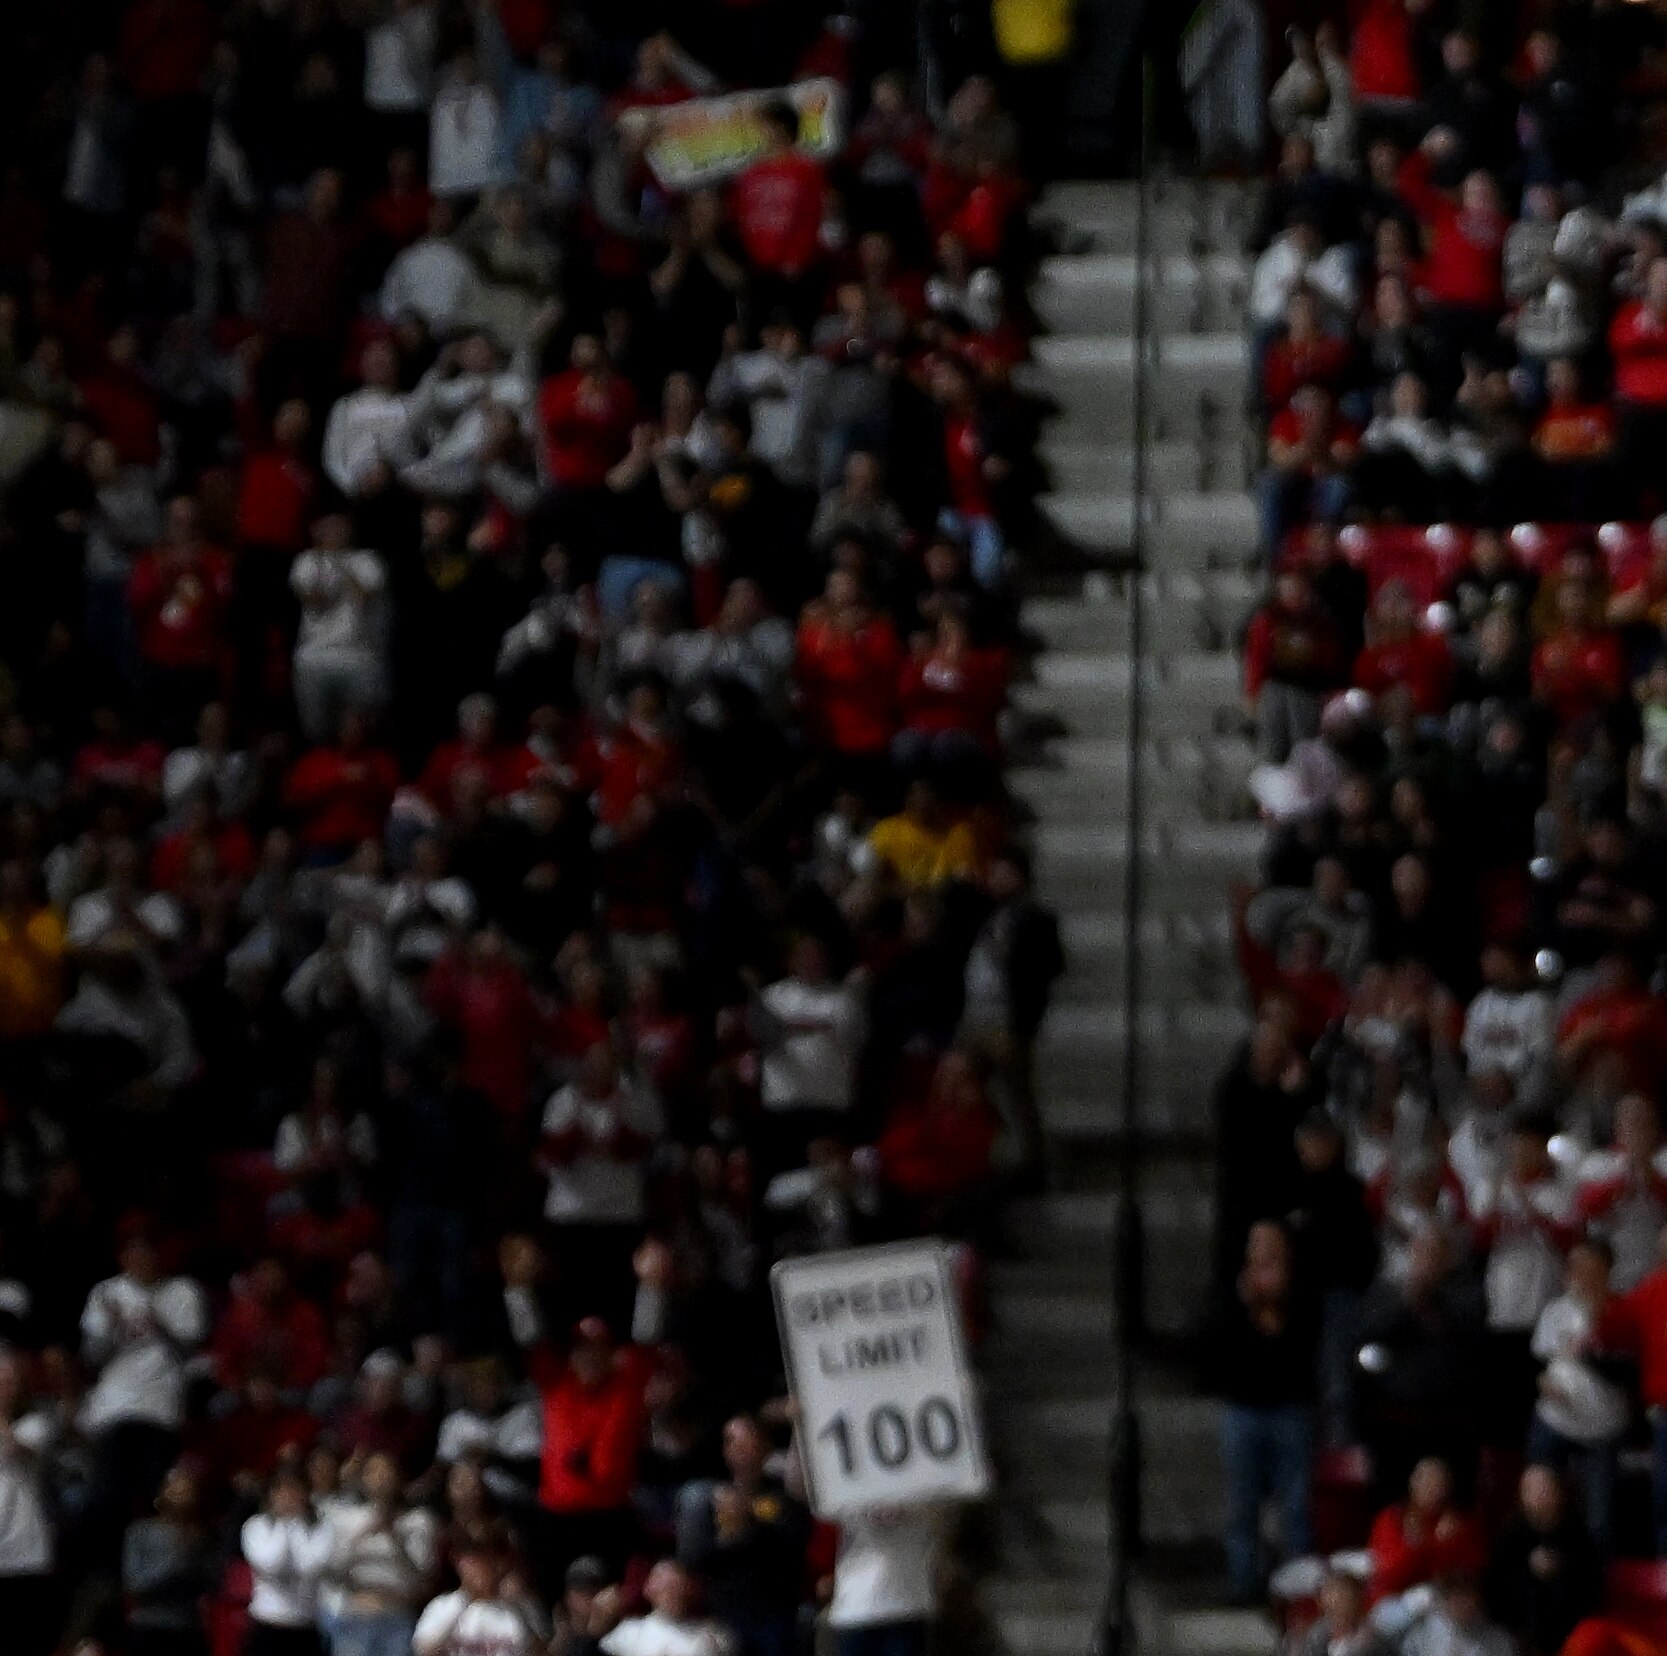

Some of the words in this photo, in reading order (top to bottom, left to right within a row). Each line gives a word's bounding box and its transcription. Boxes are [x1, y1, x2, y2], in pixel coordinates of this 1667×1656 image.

[790, 1273, 935, 1328] SPEED
[817, 1325, 927, 1377] LIMIT
[817, 1396, 960, 1479] 100
